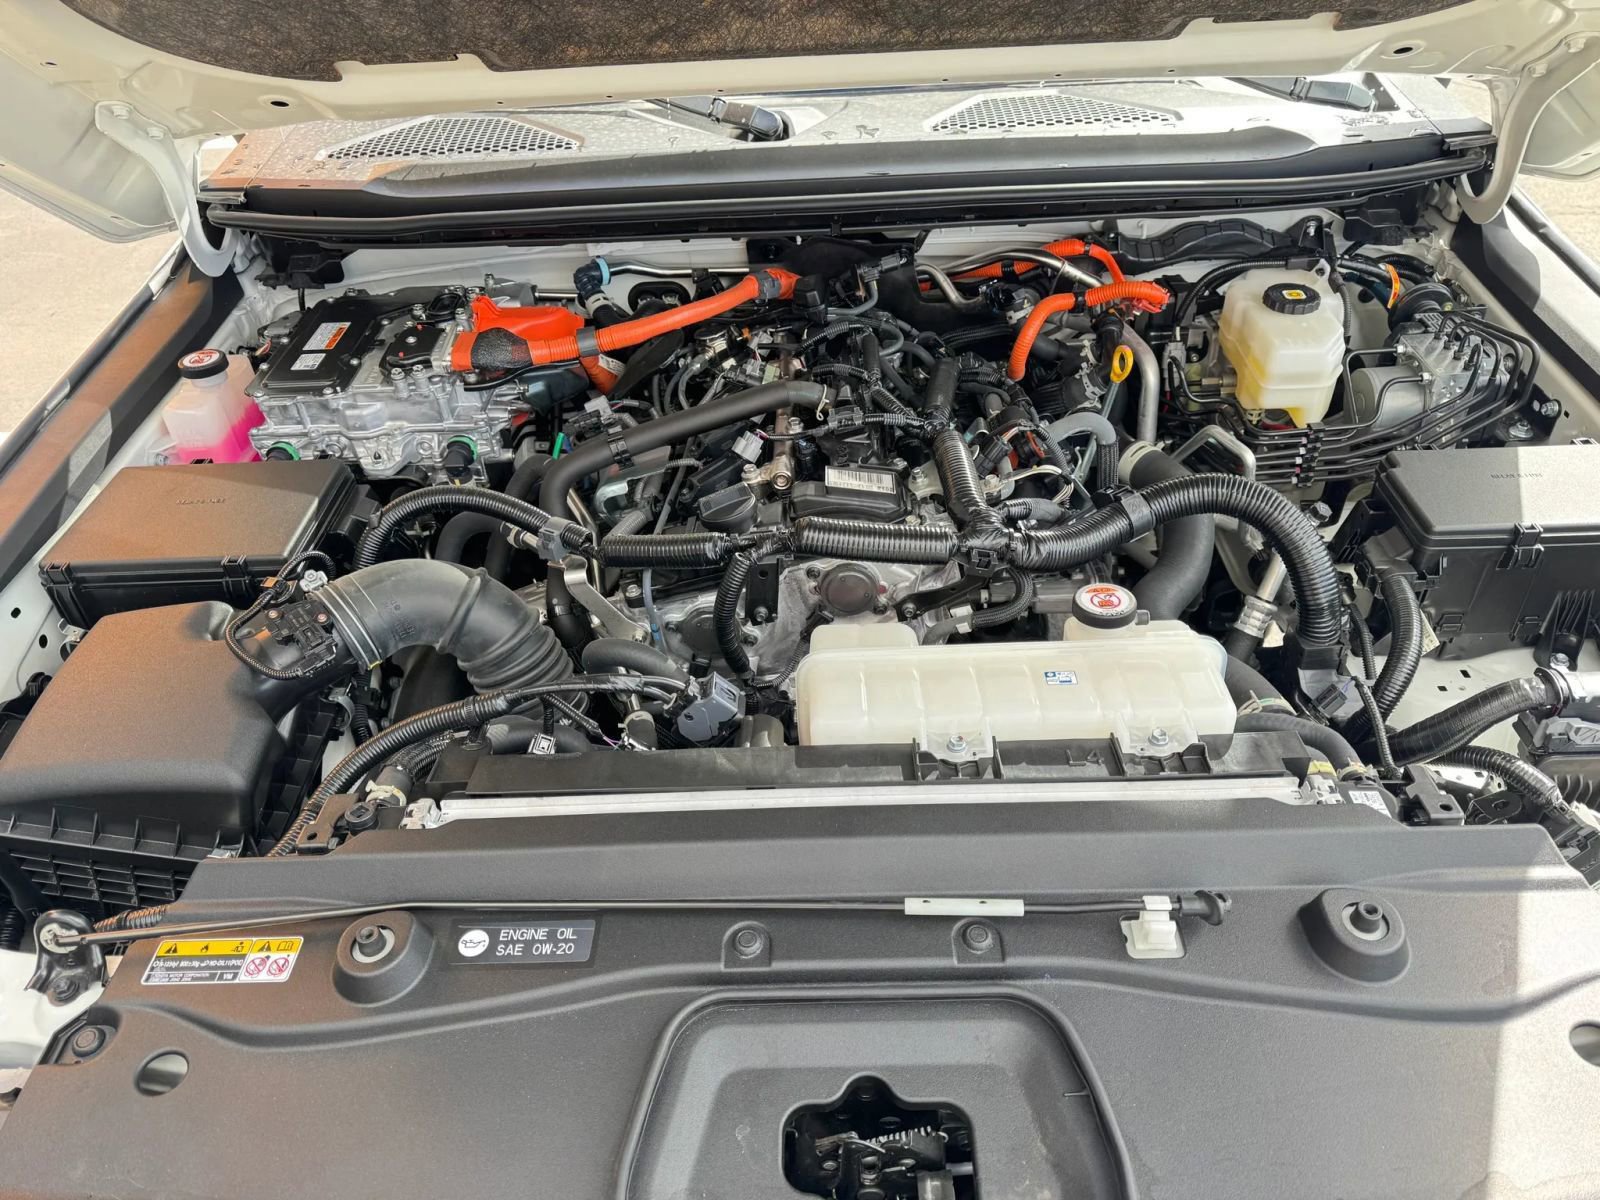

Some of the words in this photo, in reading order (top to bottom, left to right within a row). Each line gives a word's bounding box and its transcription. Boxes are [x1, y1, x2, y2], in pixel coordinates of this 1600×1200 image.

[499, 928, 549, 941] ENGINE
[556, 927, 578, 940] OIL
[495, 943, 525, 956] SAE
[532, 943, 575, 955] 0W-20
